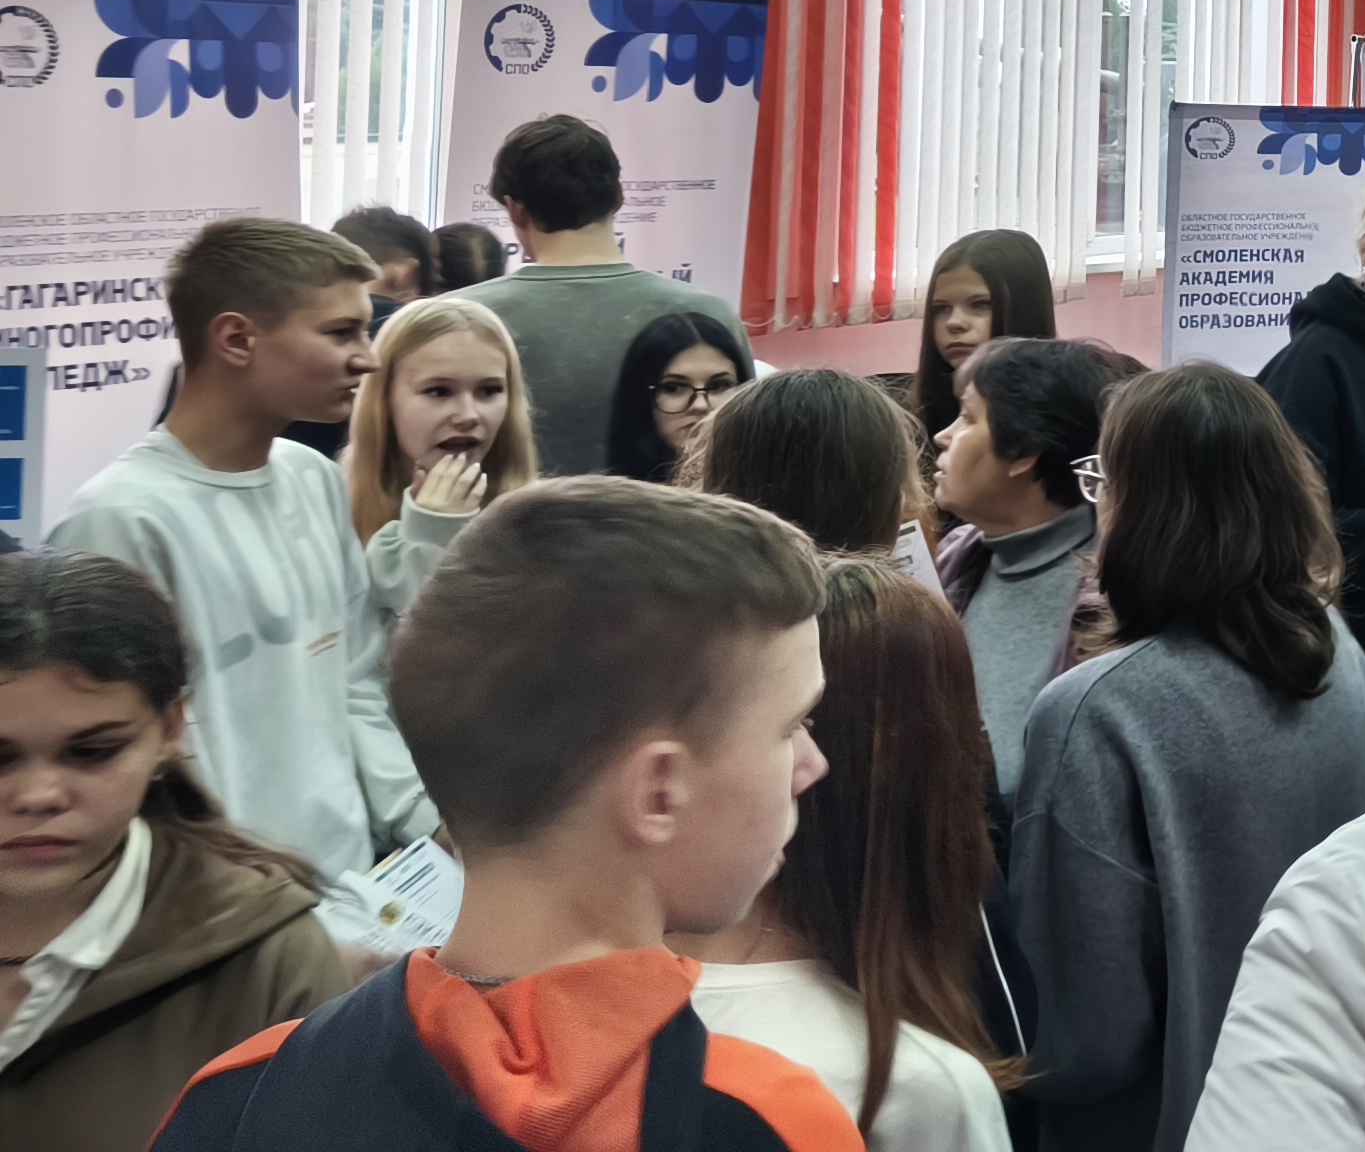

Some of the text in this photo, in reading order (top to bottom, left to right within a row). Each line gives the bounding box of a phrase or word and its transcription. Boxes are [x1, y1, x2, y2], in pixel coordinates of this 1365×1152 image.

[505, 63, 530, 75] СПО
[1181, 212, 1307, 222] ОБЛАСТНОЕ ГОСУДАРСТВЕННОЕ
[1181, 248, 1305, 264] «СМОЛЕНСКАЯ
[1179, 270, 1275, 287] АКАДЕМИЯ
[0, 278, 164, 311] ГАГАРИНСК
[1179, 291, 1305, 308] ПРОФЕССИОНА
[1179, 313, 1290, 330] ОБРАЗОВАНИ
[46, 359, 151, 393] ЛЕДЖ»
